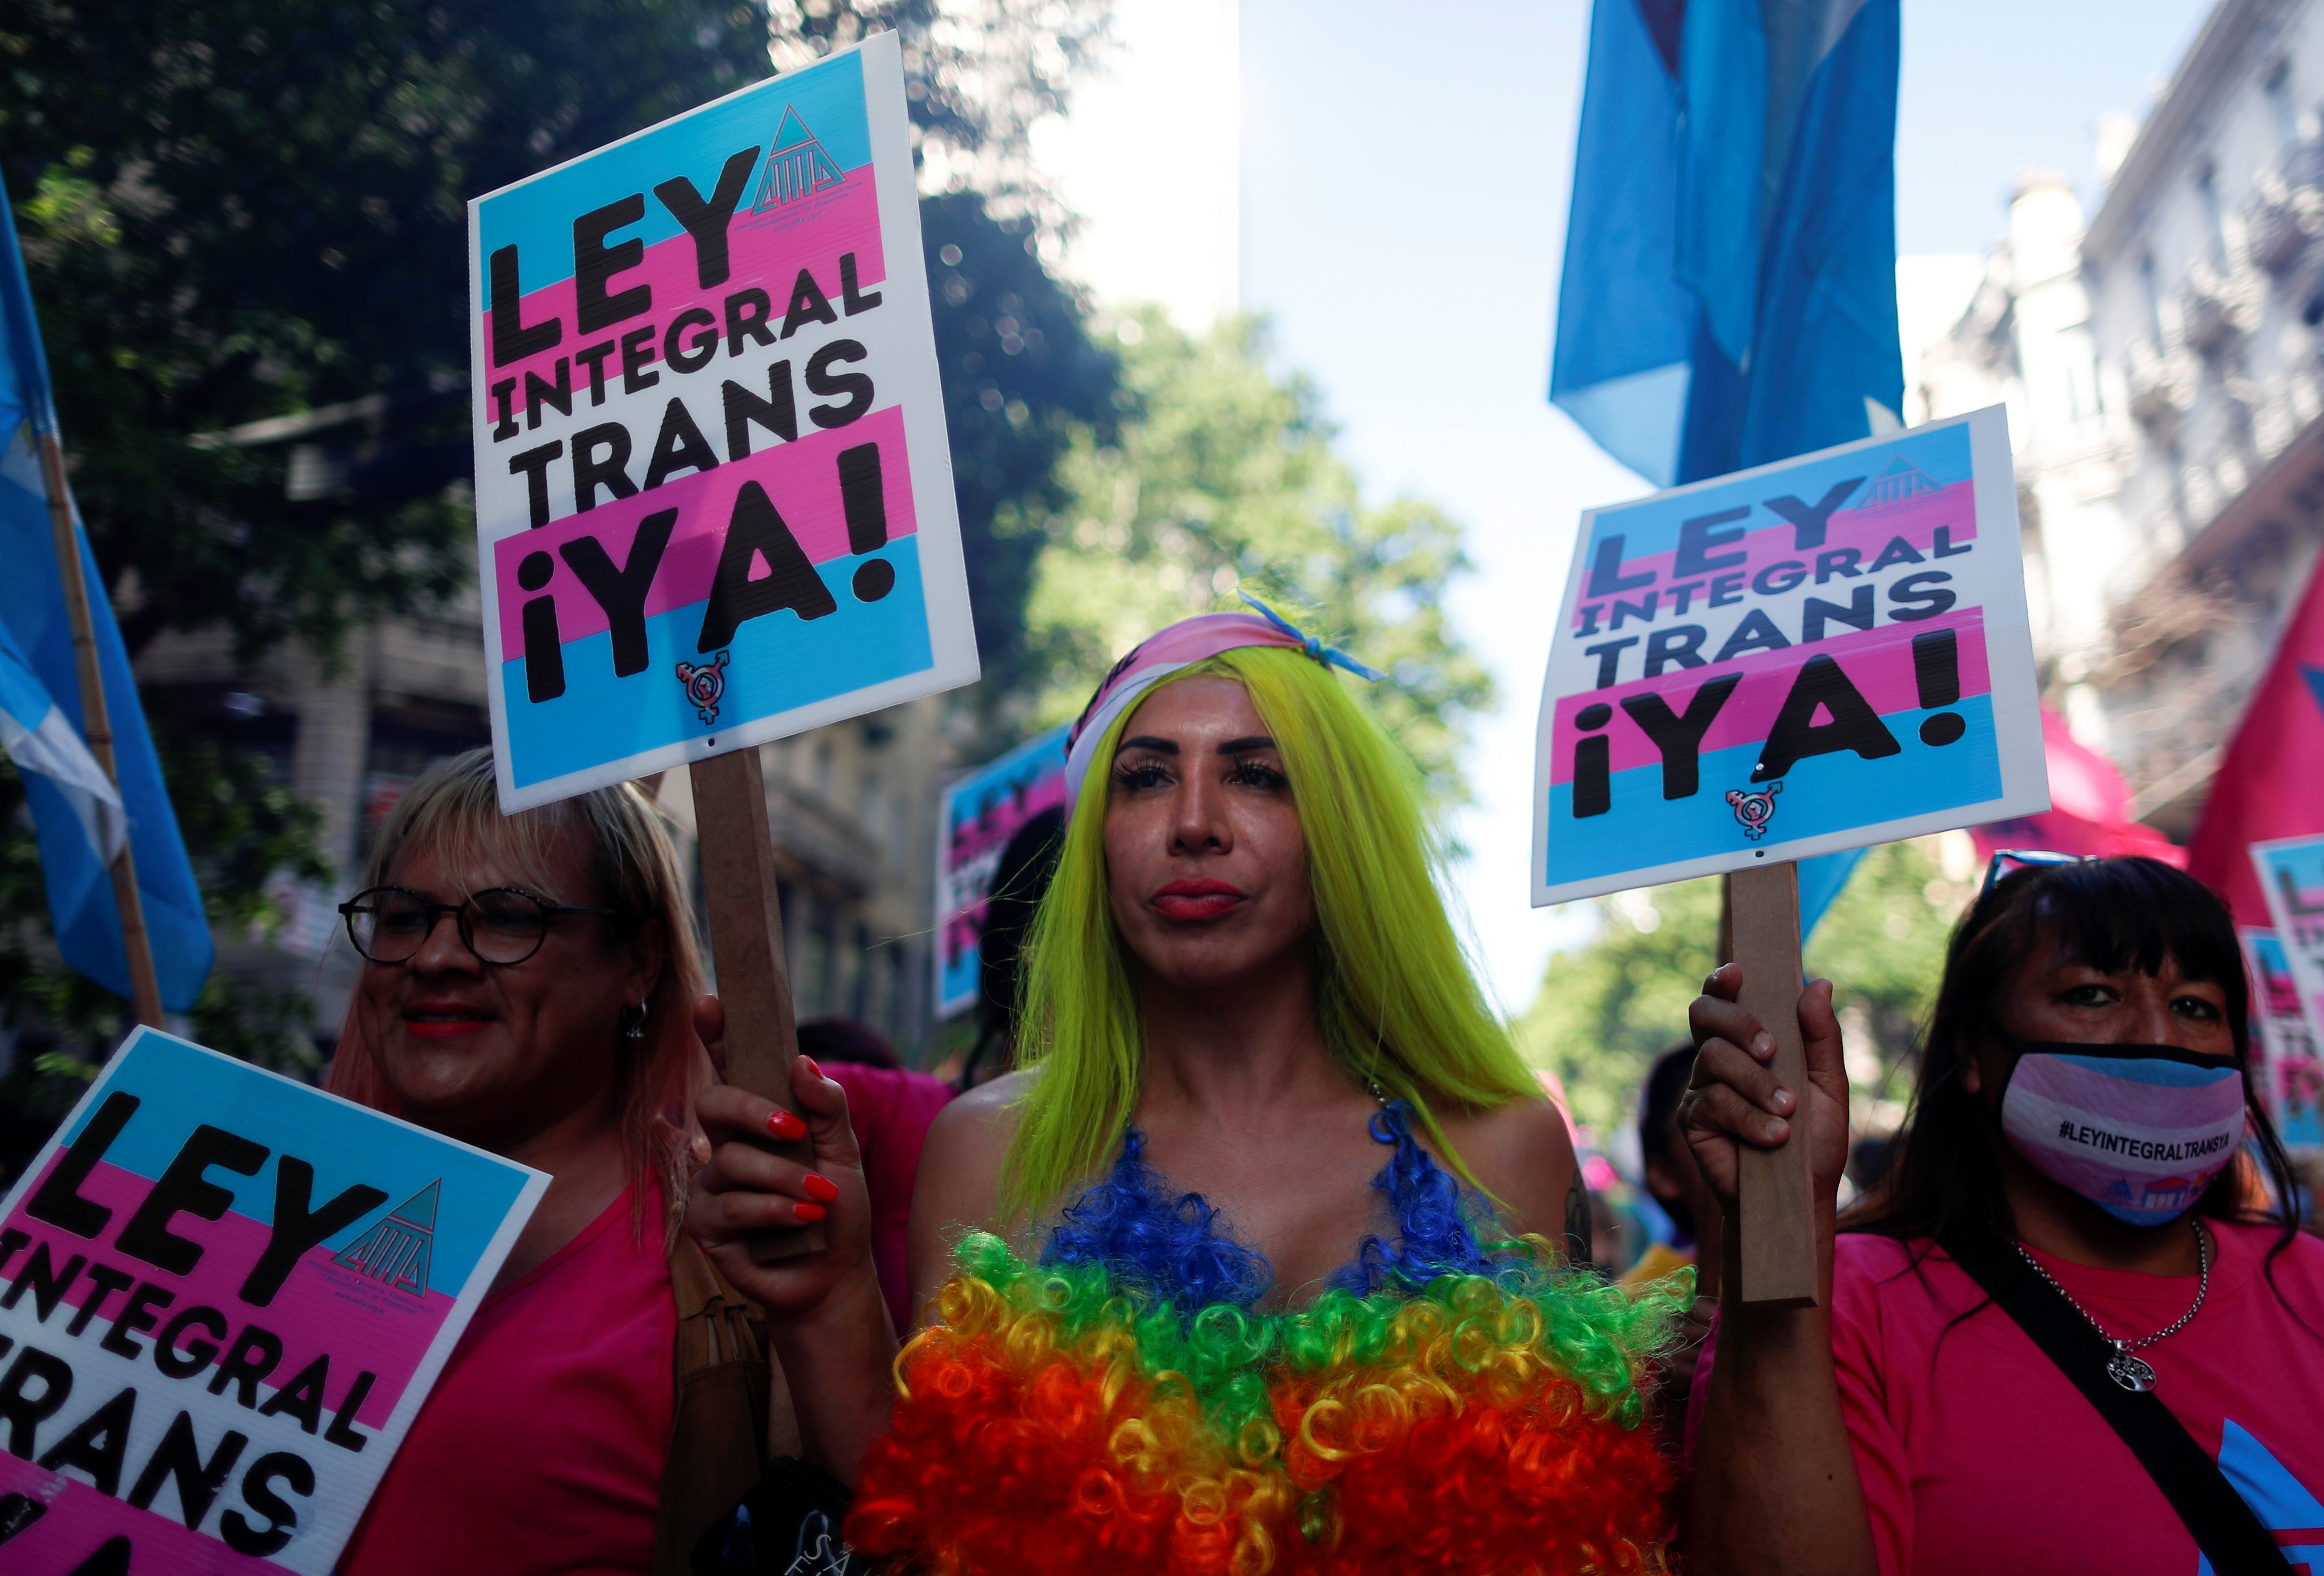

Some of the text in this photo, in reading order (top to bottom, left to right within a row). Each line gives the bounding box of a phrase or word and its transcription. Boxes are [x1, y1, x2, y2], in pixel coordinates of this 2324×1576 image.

[490, 145, 761, 368] LEY
[491, 252, 882, 443] INTEGRAL
[509, 338, 875, 529] TRANS
[517, 441, 896, 704] ¡YA!
[1574, 525, 1972, 638] INTEGRAL
[1585, 571, 1956, 690] TRANS
[1586, 475, 1867, 598] LEY
[1572, 628, 1966, 819] ¡YA!
[25, 1091, 389, 1308] LEY
[2058, 1120, 2229, 1161] #LEYINTEGRALTRANSYA
[0, 1334, 315, 1558] RANS
